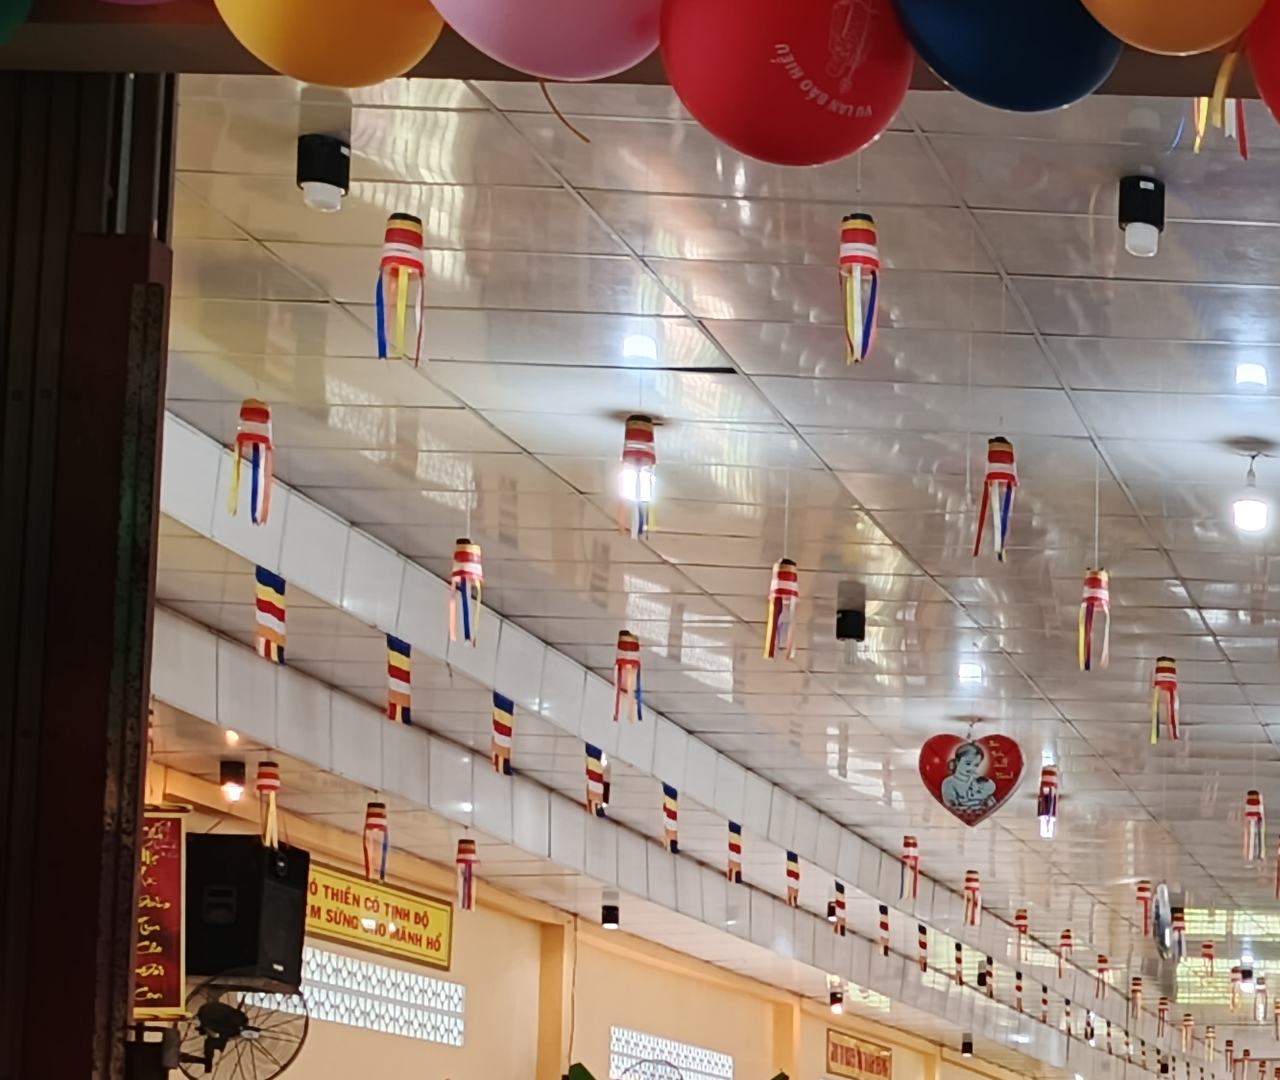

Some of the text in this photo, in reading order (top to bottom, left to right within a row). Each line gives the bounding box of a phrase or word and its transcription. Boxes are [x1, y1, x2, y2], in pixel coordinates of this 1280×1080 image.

[855, 104, 872, 117] VU
[364, 896, 380, 913] CÓ
[413, 910, 430, 931] ĐỘ
